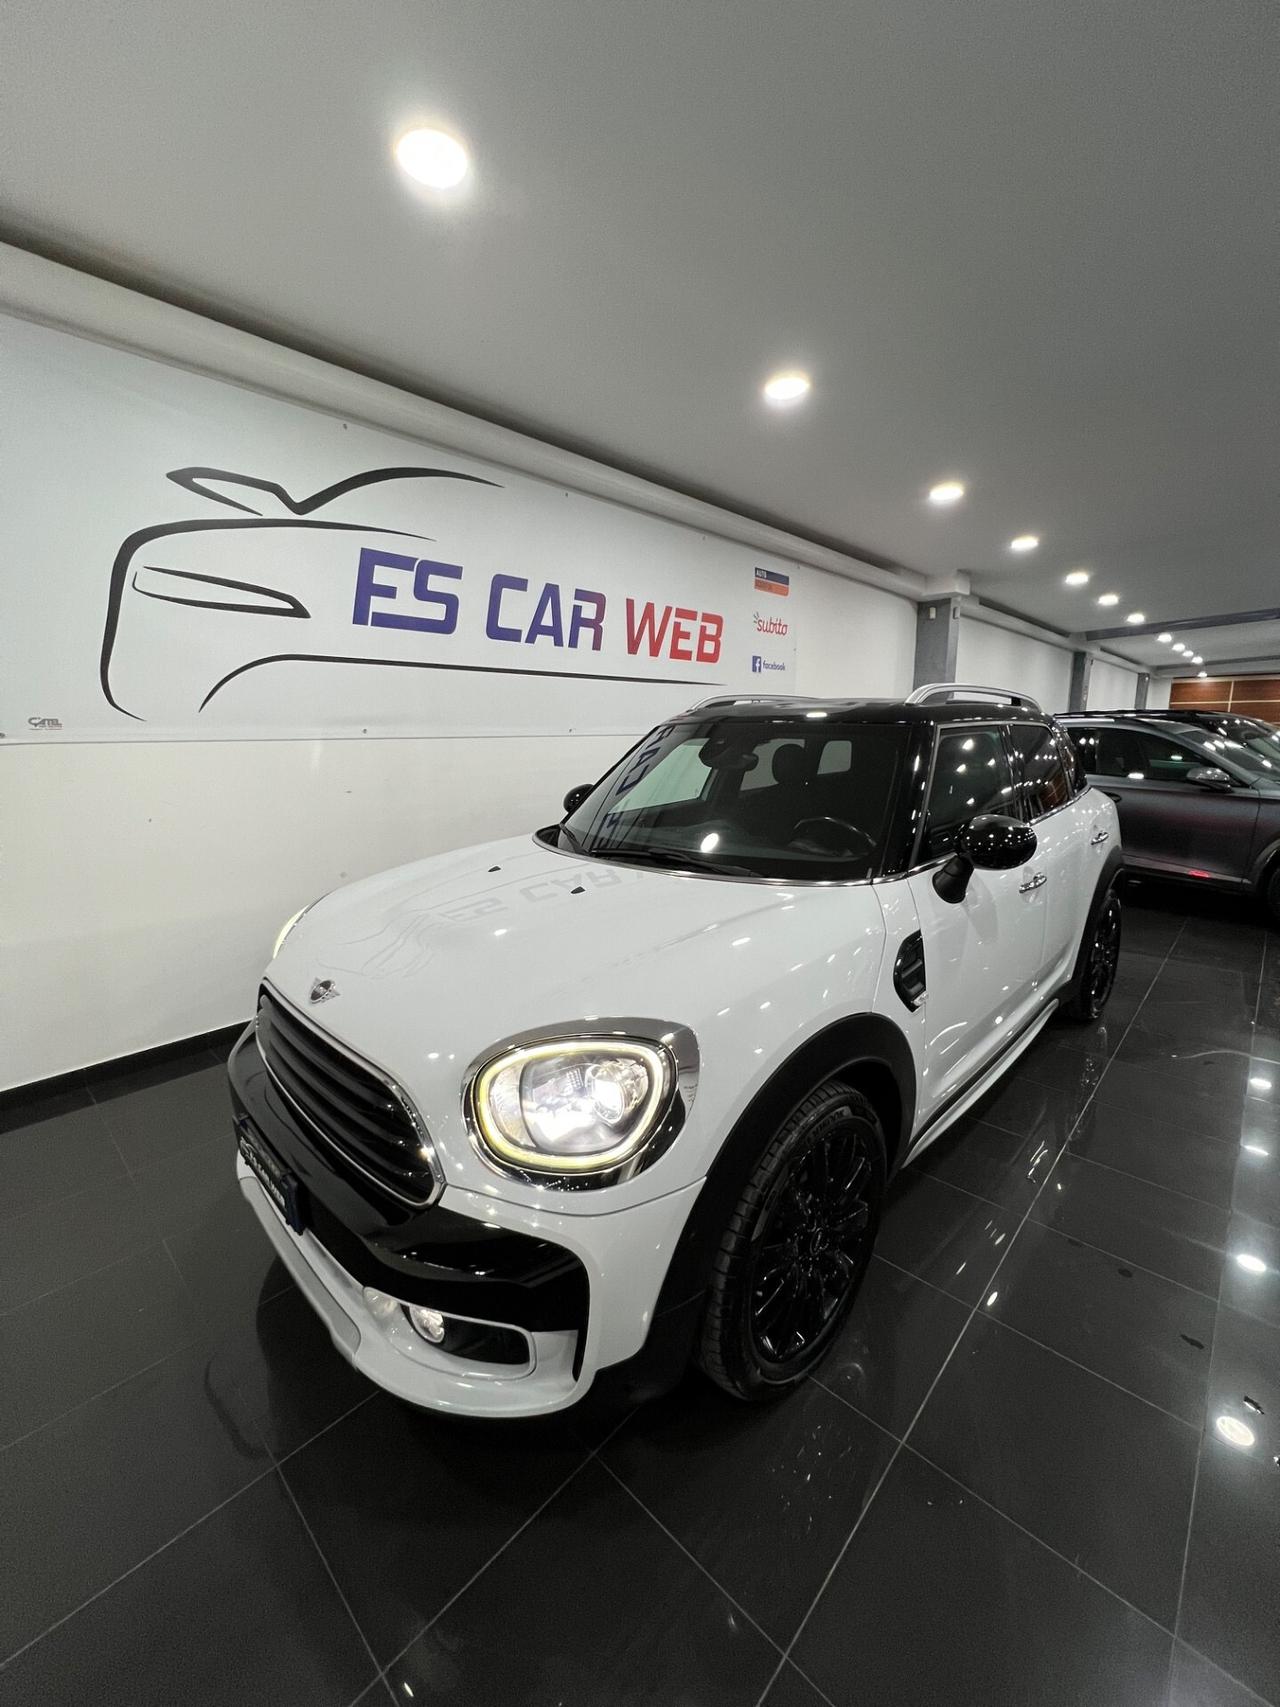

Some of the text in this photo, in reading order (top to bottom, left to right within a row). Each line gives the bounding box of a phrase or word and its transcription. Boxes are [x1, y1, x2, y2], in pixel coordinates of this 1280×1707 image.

[352, 547, 724, 664] ES CAR WEB
[756, 616, 788, 636] subito
[762, 660, 785, 671] facebook
